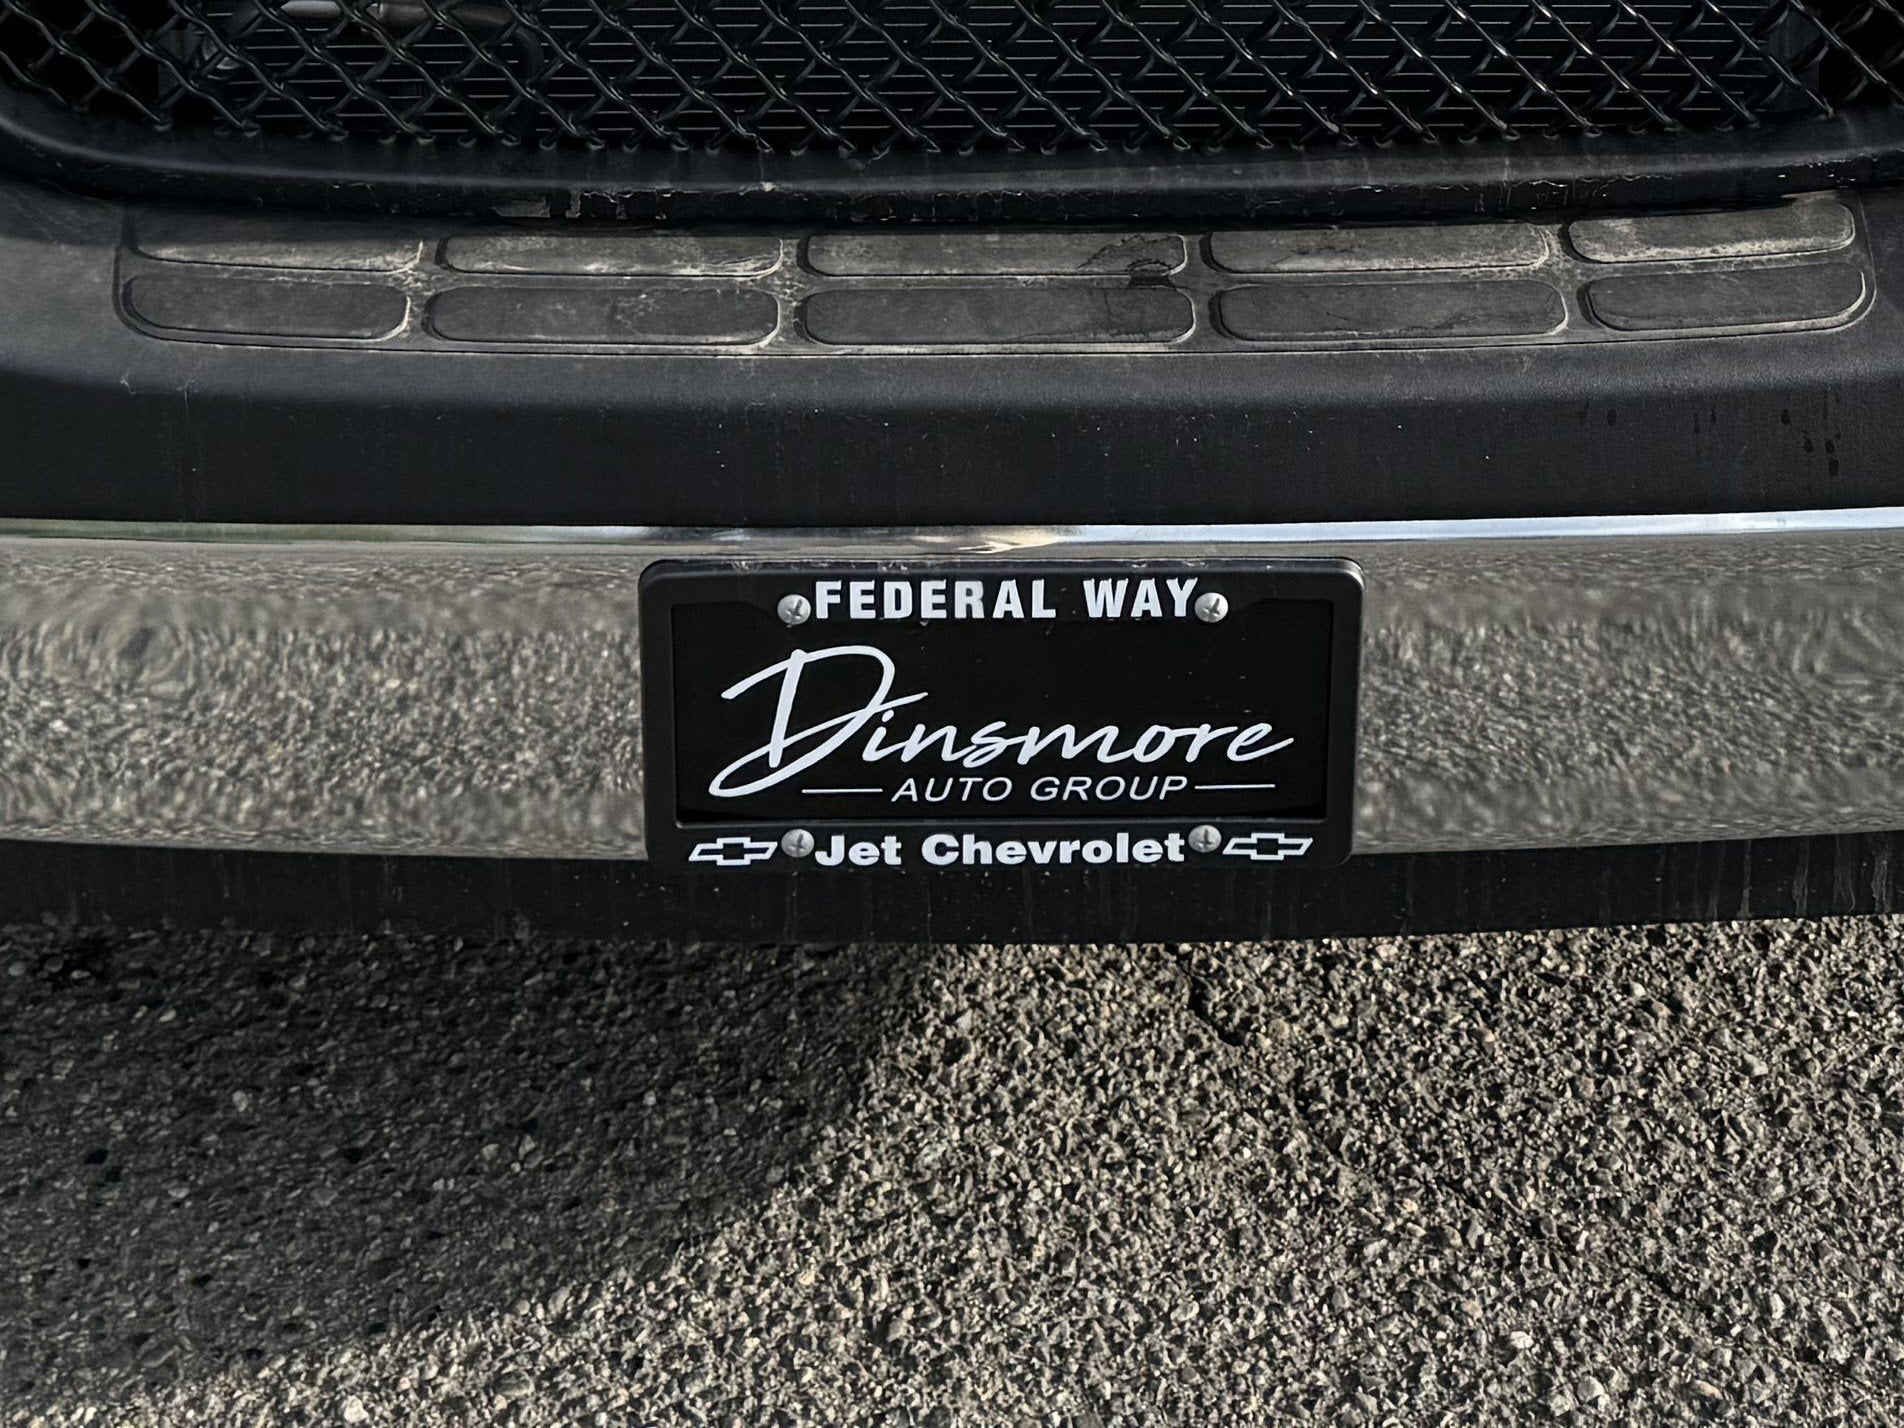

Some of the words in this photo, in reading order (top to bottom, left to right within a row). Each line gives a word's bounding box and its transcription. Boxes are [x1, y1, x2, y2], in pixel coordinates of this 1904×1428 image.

[815, 578, 1057, 620] FEDERAL
[1082, 577, 1199, 618] WAY
[708, 645, 1295, 798] Dinsmore
[890, 776, 1013, 802] AUTO
[1030, 775, 1189, 801] GROUP
[814, 834, 902, 866] Jet
[921, 832, 1185, 866] Chevrolet
